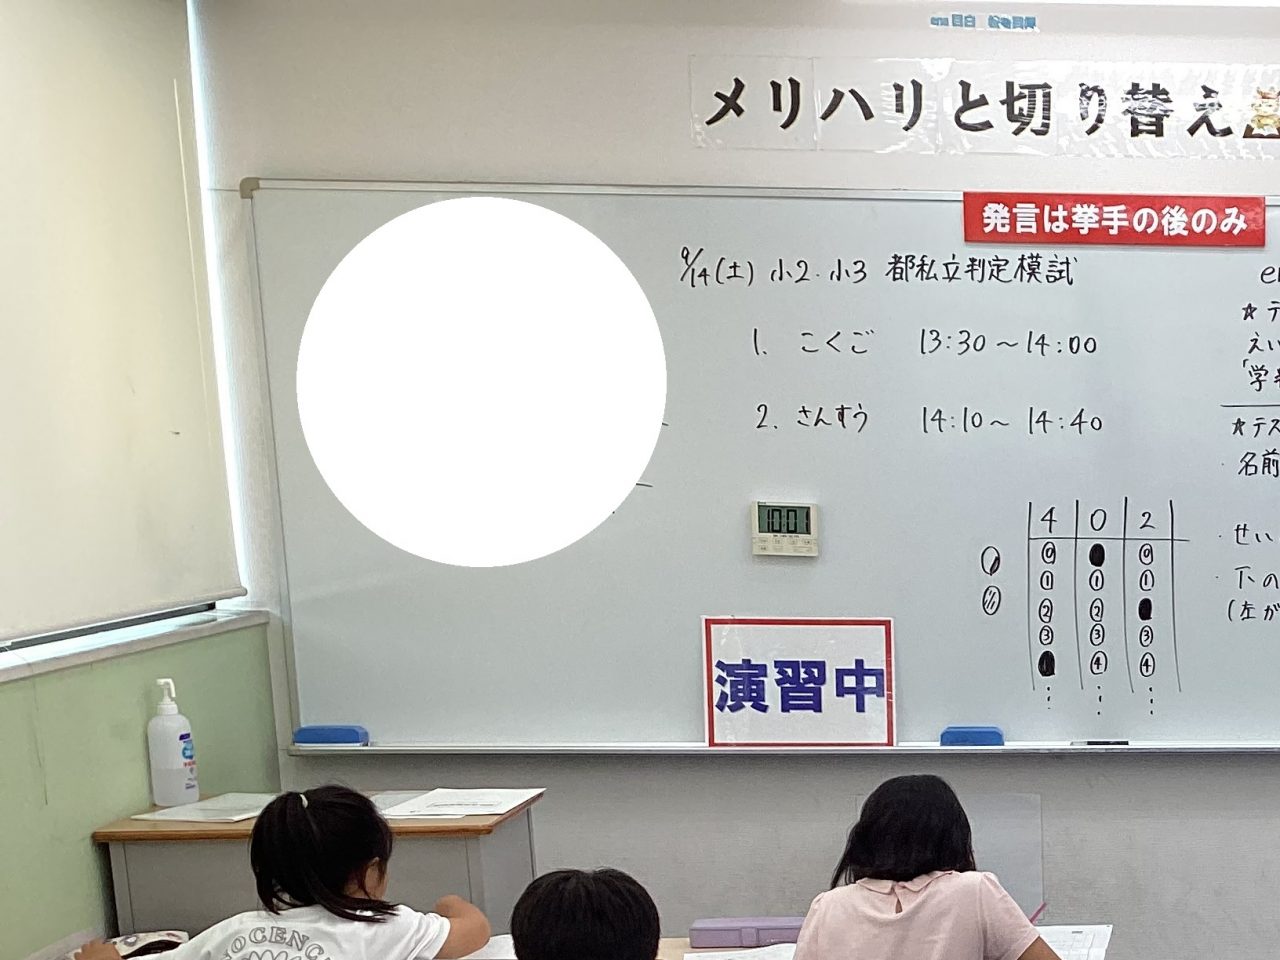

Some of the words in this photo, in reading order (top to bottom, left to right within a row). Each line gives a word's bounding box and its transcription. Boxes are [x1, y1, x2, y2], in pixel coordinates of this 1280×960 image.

[704, 76, 1234, 138] メリハリと切り替え
[982, 203, 1248, 237] 発言は挙手の後のみ
[884, 252, 1078, 287] 都私立判定模試
[800, 329, 875, 355] こくご
[796, 402, 868, 434] さんすう
[1040, 506, 1058, 535] 4
[1139, 511, 1156, 530] 2
[715, 659, 885, 713] 演習中
